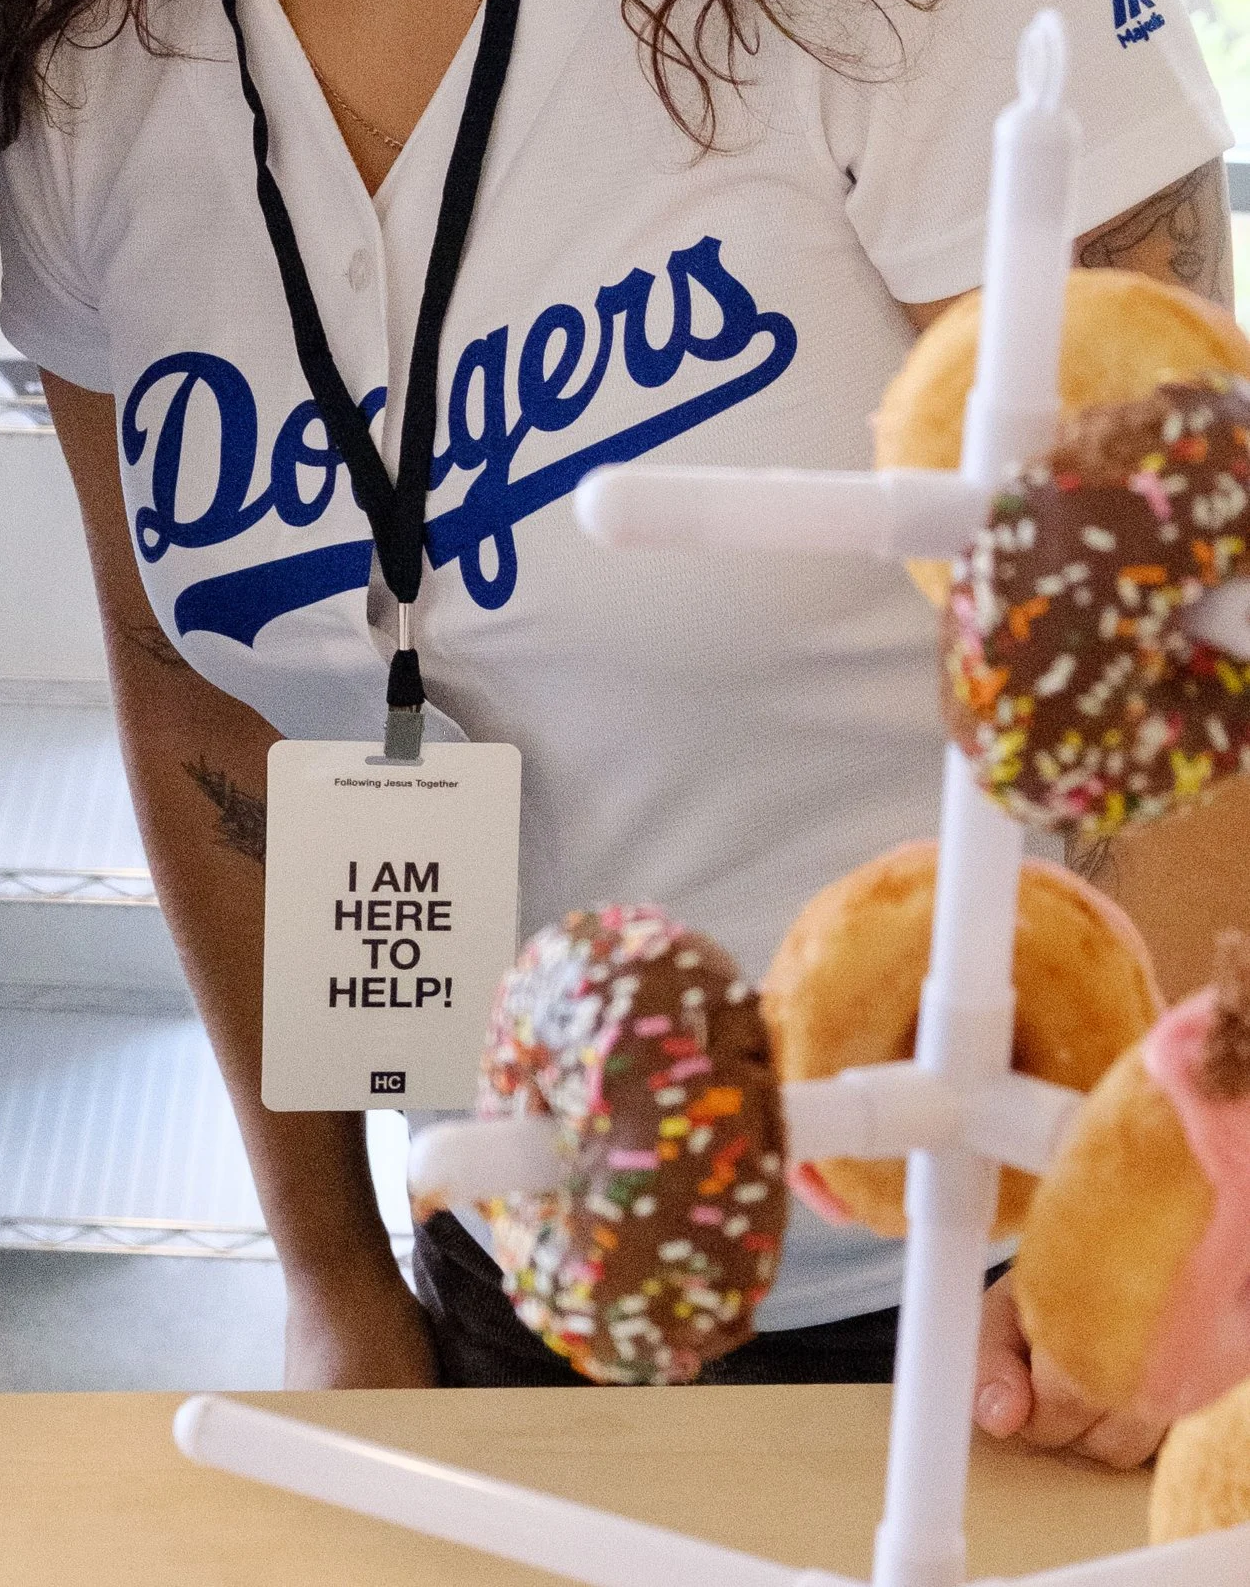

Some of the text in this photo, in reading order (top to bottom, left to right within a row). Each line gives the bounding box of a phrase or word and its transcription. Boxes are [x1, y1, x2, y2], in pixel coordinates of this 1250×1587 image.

[334, 778, 459, 790] Following Jesus Together
[349, 861, 440, 893] I AM
[335, 900, 452, 931] HERE
[362, 938, 421, 970] TO
[329, 977, 452, 1008] HELP!
[374, 1074, 402, 1091] HC
